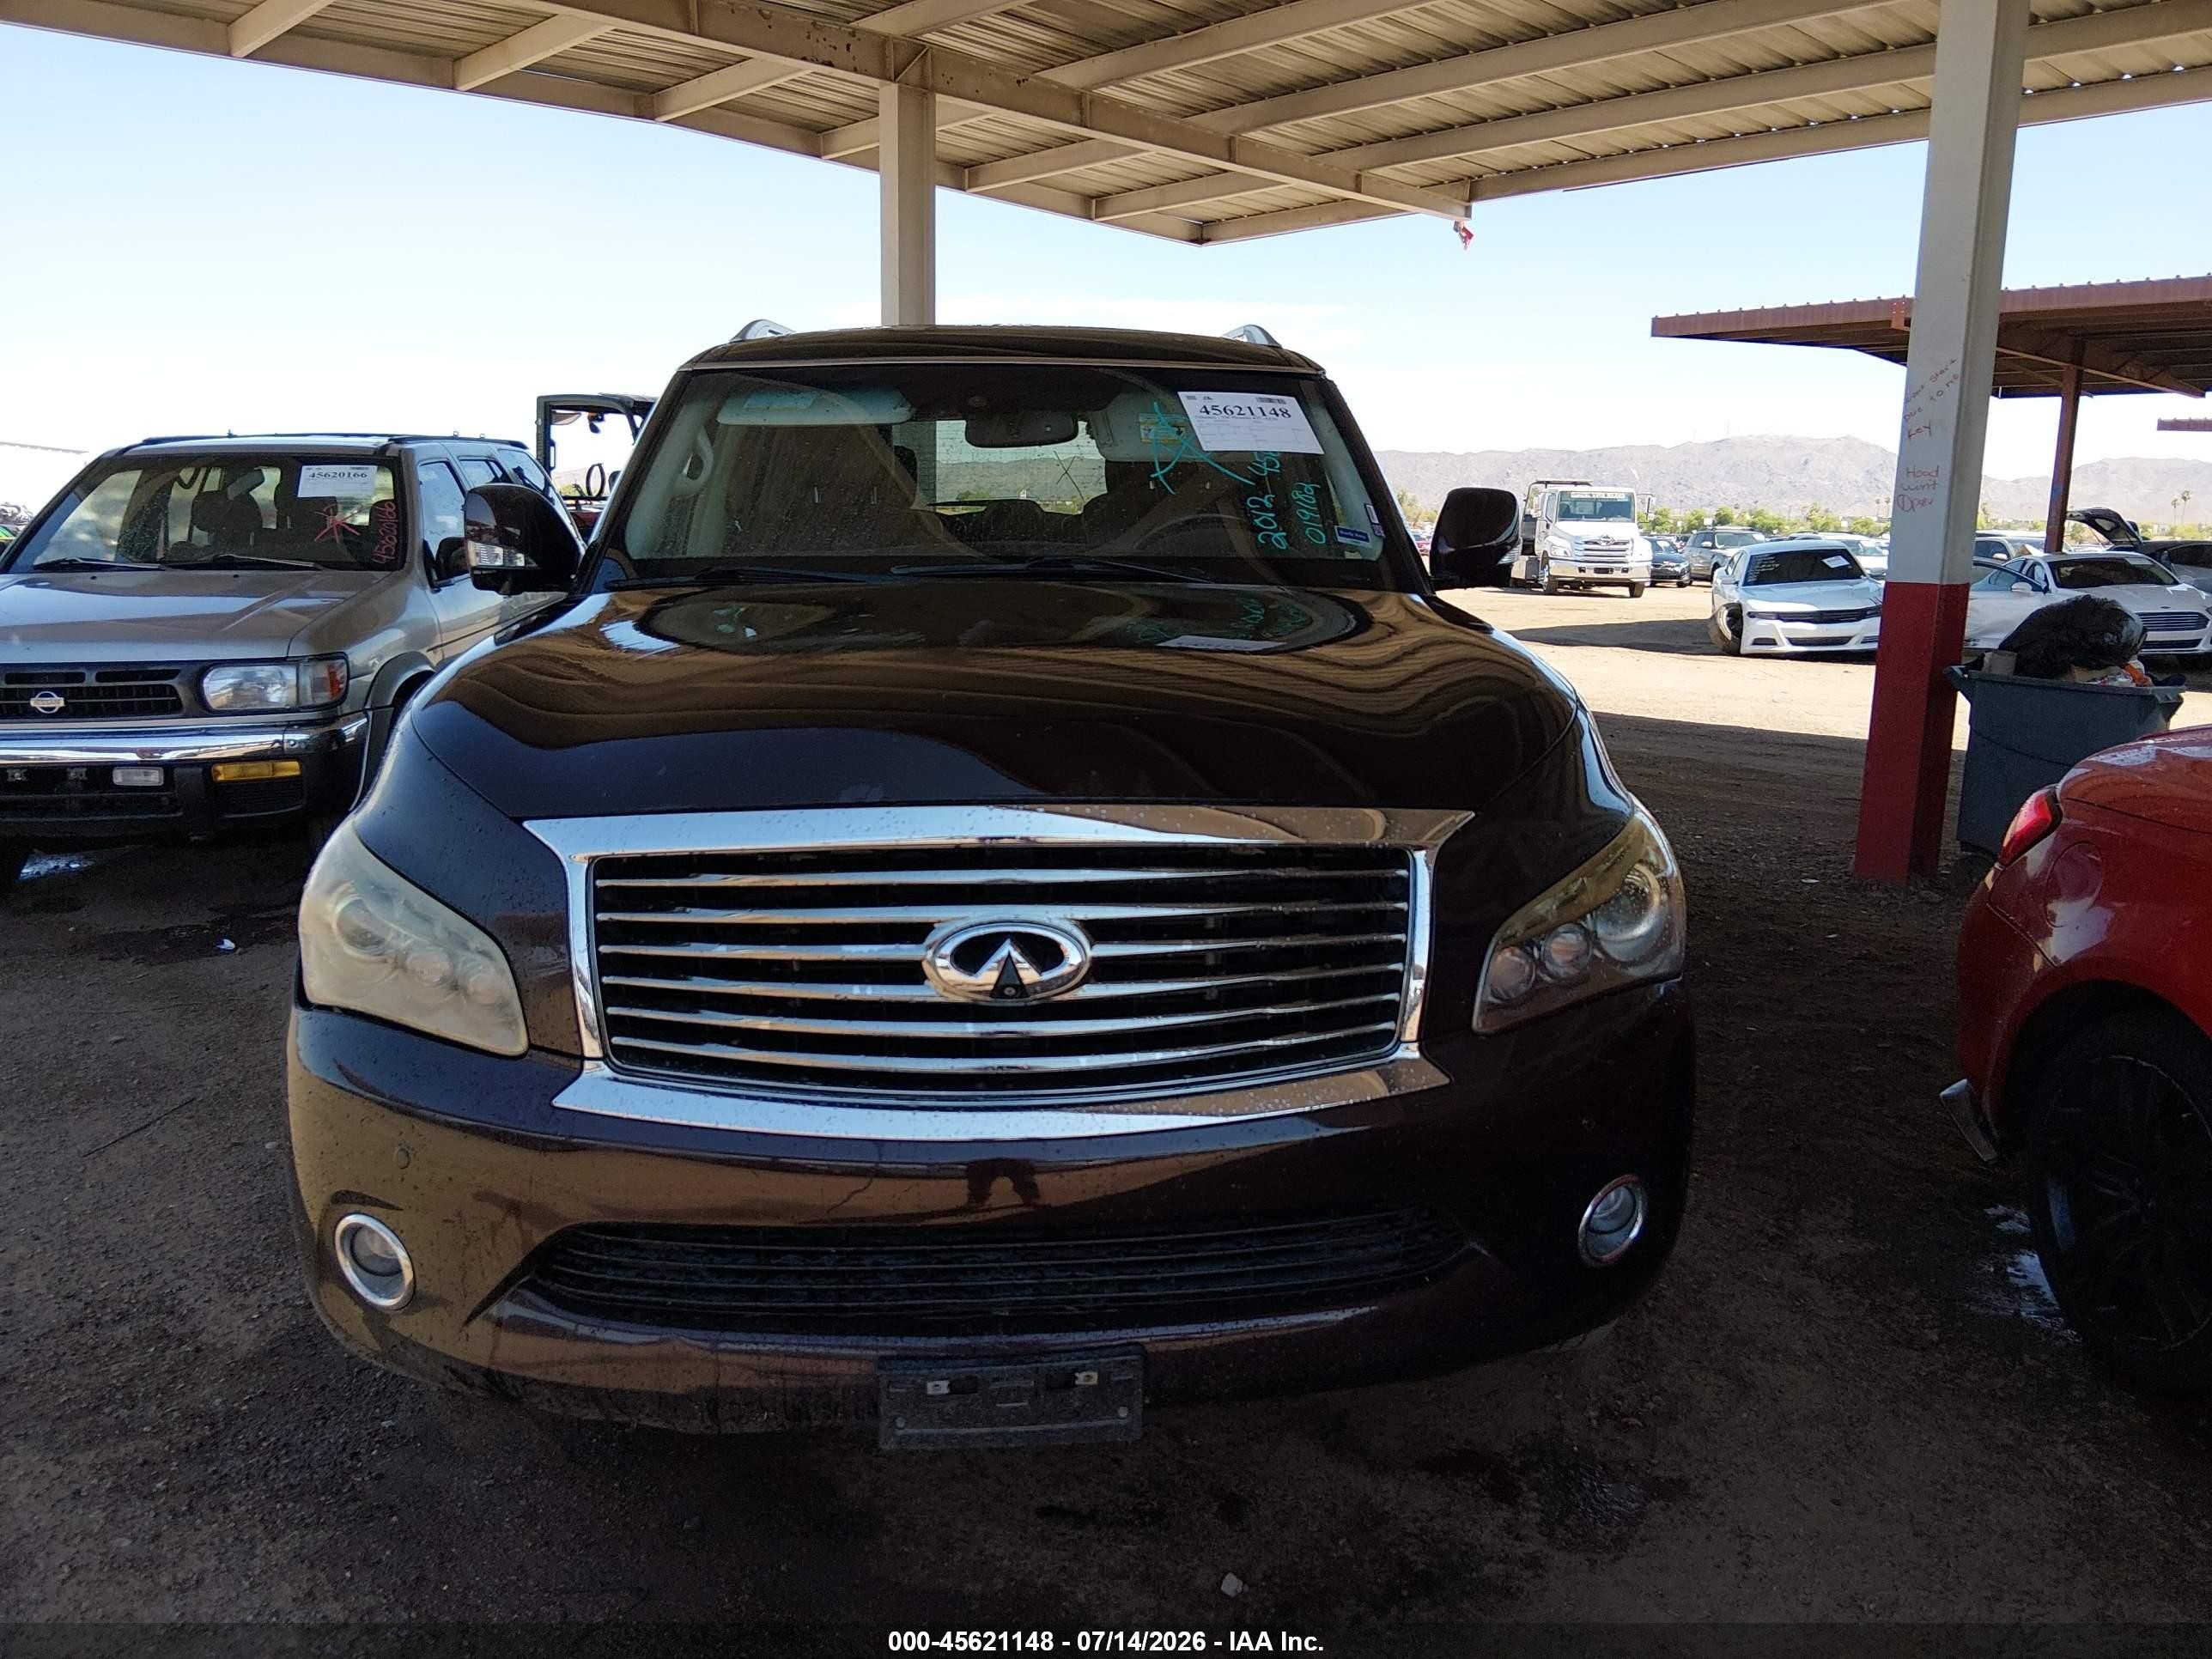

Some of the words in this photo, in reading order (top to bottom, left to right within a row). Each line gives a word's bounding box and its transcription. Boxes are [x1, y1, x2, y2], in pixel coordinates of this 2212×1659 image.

[1199, 404, 1292, 420] 45621148
[308, 471, 368, 479] 45620166
[1246, 494, 1287, 550] 2012
